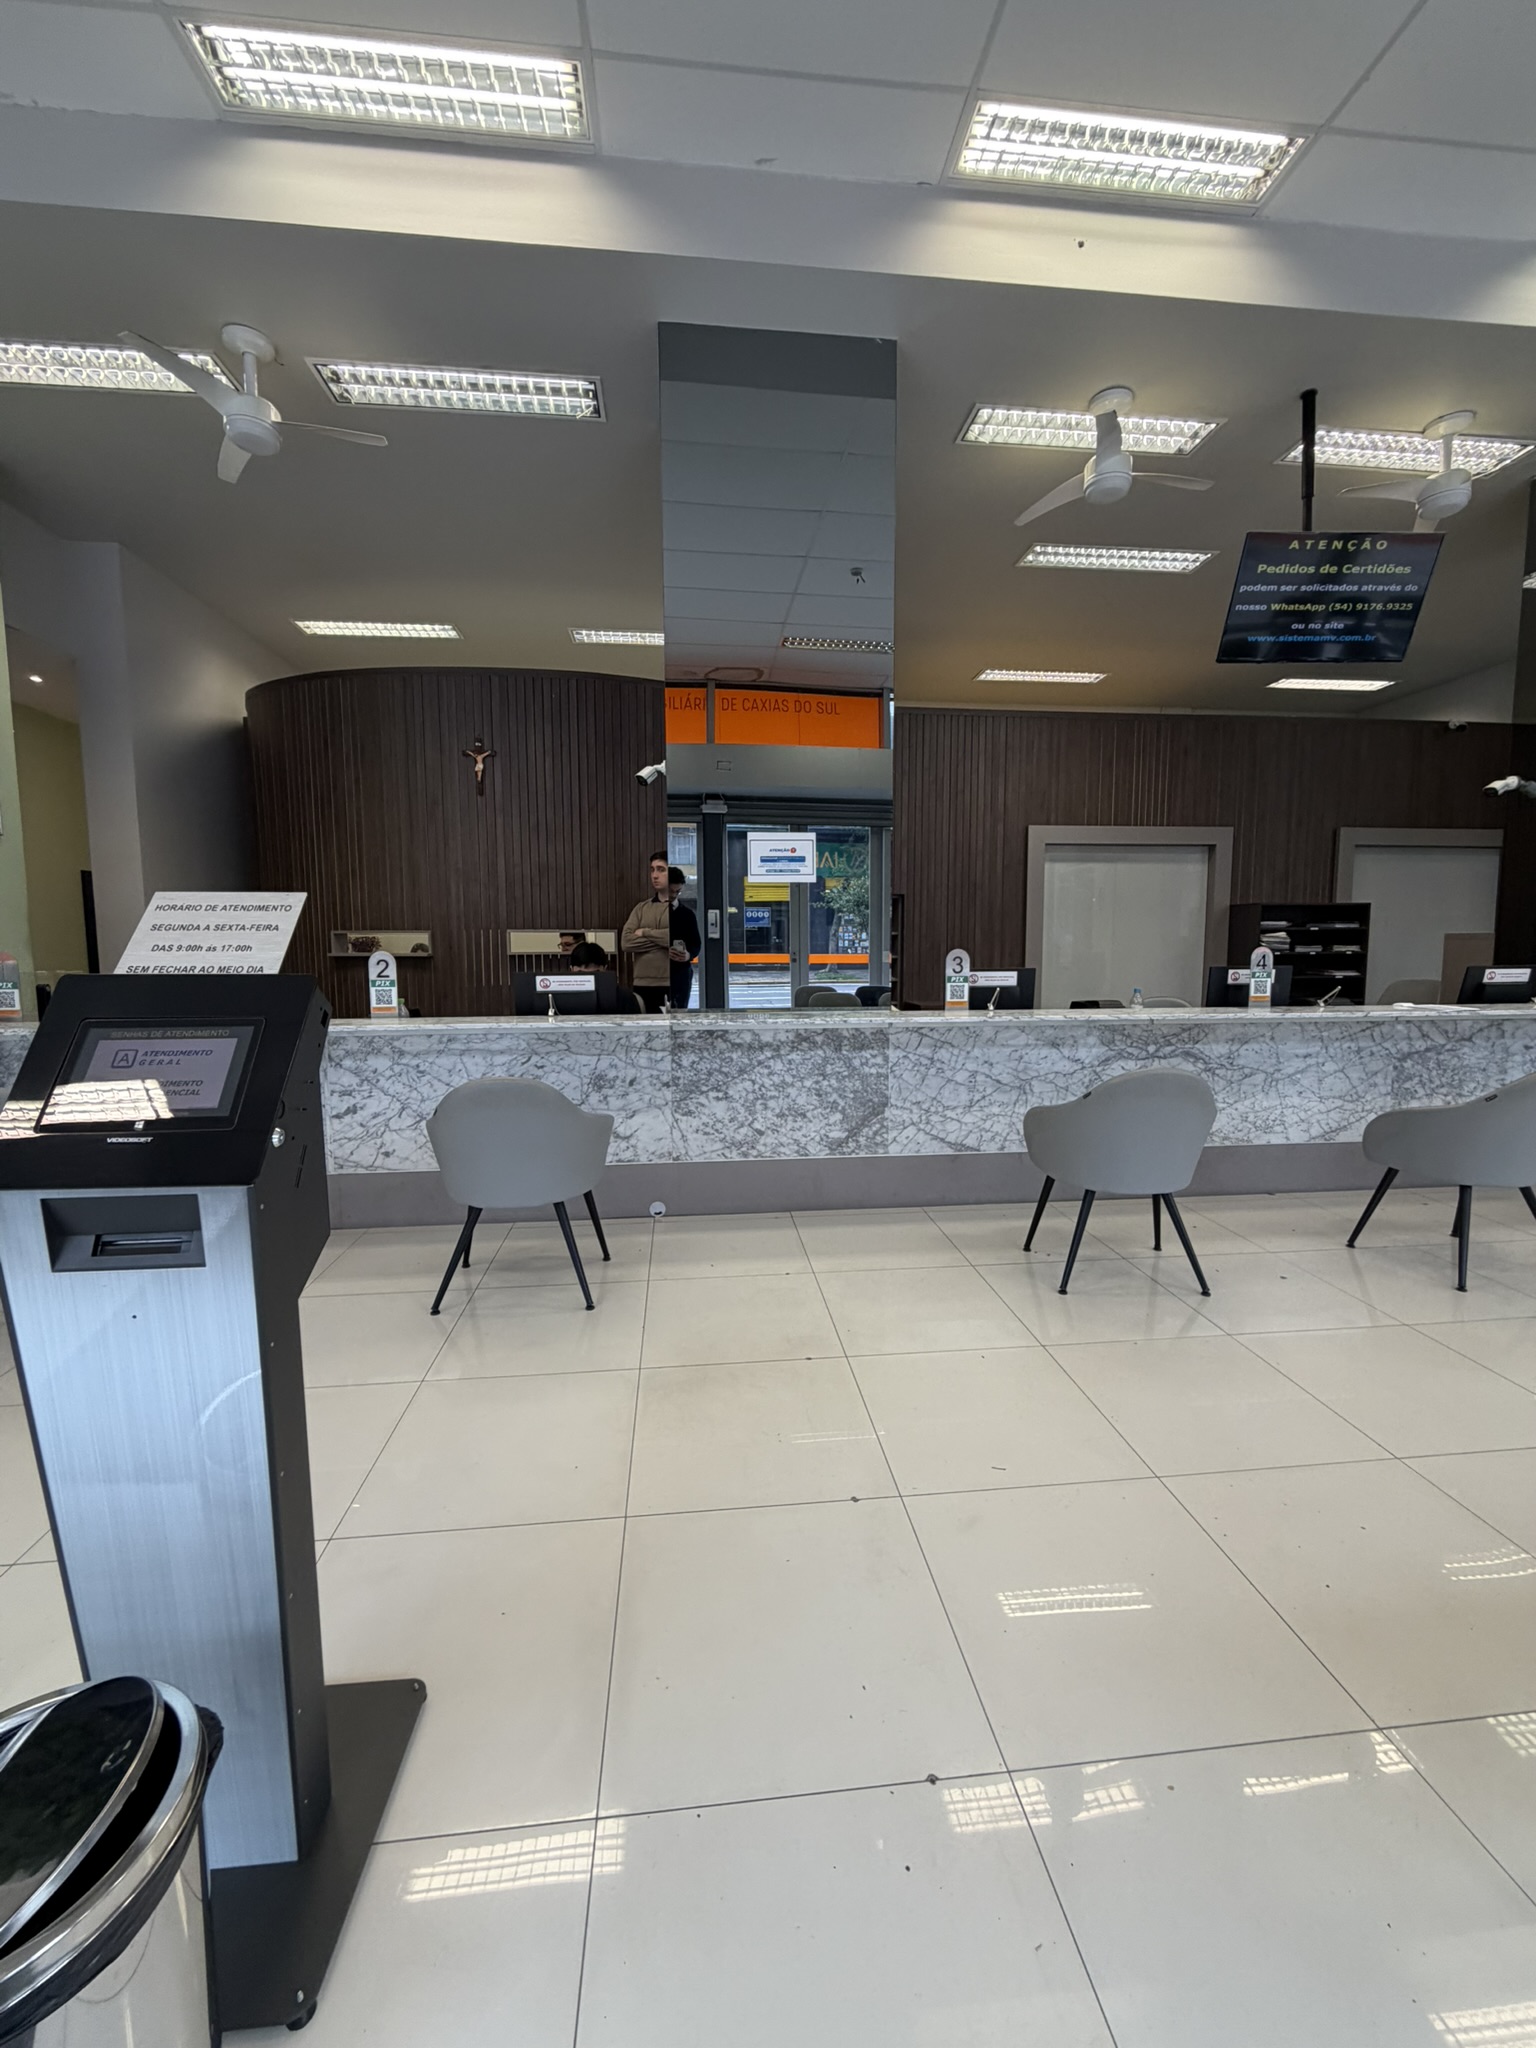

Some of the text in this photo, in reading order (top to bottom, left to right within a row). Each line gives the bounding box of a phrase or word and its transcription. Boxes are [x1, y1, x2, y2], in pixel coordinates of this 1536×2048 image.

[1288, 538, 1388, 552] ATENÇÃO
[1257, 563, 1412, 574] Pedidos de Certidões
[1239, 583, 1277, 593] podem
[1300, 583, 1358, 592] solicitados
[1361, 583, 1401, 592] através
[1404, 583, 1418, 592] do
[1270, 602, 1326, 613] WhatsApp
[1328, 602, 1353, 613] (54)
[1355, 603, 1413, 611] 9176.9325
[1307, 622, 1322, 630] no
[1324, 621, 1344, 630] site
[1247, 633, 1377, 643] www.sistemamv.com.br
[665, 692, 841, 715] ILIÁRI DE CAXIAS DO SUL
[154, 902, 292, 912] HORÁRIO DE ATENDIMENTO
[150, 923, 280, 932] SEGUNDA A SEXTA-FEIRA
[151, 944, 174, 952] DAS
[175, 944, 203, 952] 9:00h
[220, 944, 253, 952] 17:00h
[952, 956, 963, 974] 3
[1256, 954, 1267, 969] 4
[126, 965, 264, 974] SEM FECHAR AO MEIO DIA
[376, 959, 390, 978] 2
[111, 1029, 230, 1039] SENHAS DE ATENDIMENTO
[141, 1049, 213, 1057] ATENDIMENTO
[118, 1053, 129, 1064] A
[138, 1058, 182, 1066] GERAL
